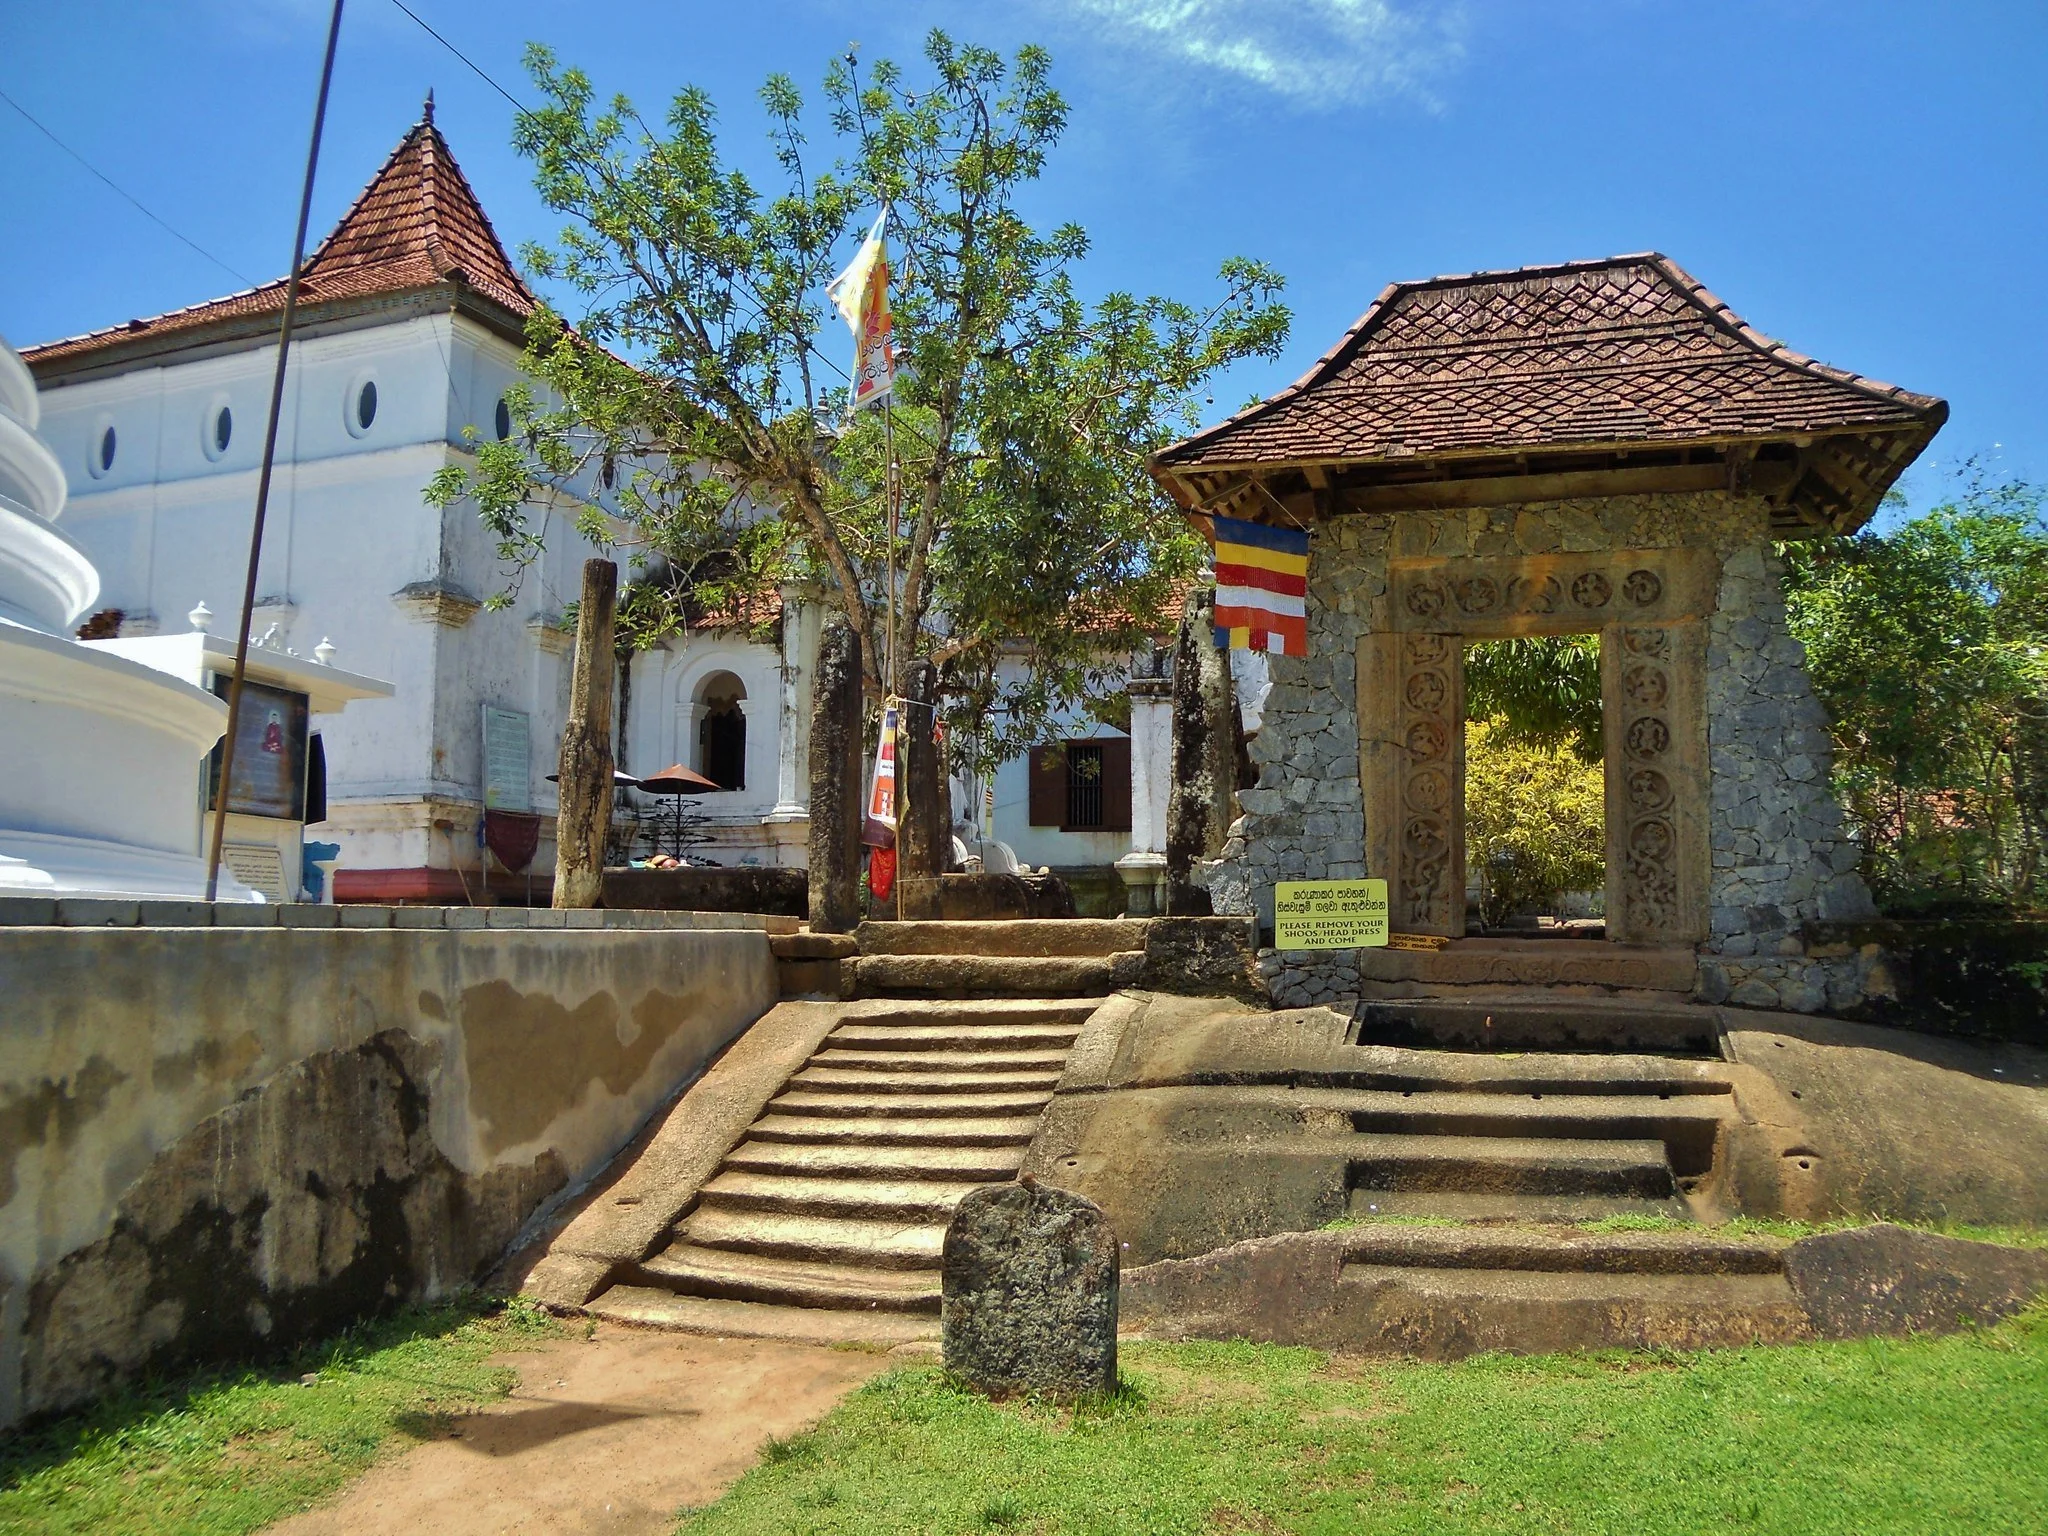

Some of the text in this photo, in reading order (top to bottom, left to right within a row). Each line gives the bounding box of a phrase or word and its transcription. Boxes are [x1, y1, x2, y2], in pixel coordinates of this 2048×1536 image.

[1293, 888, 1334, 900] කරුණාකර
[1315, 901, 1338, 913] ගලවා
[1315, 920, 1354, 928] REMOVE
[1357, 920, 1384, 928] YOUR
[1352, 927, 1381, 936] DRESS
[1328, 936, 1357, 944] COME
